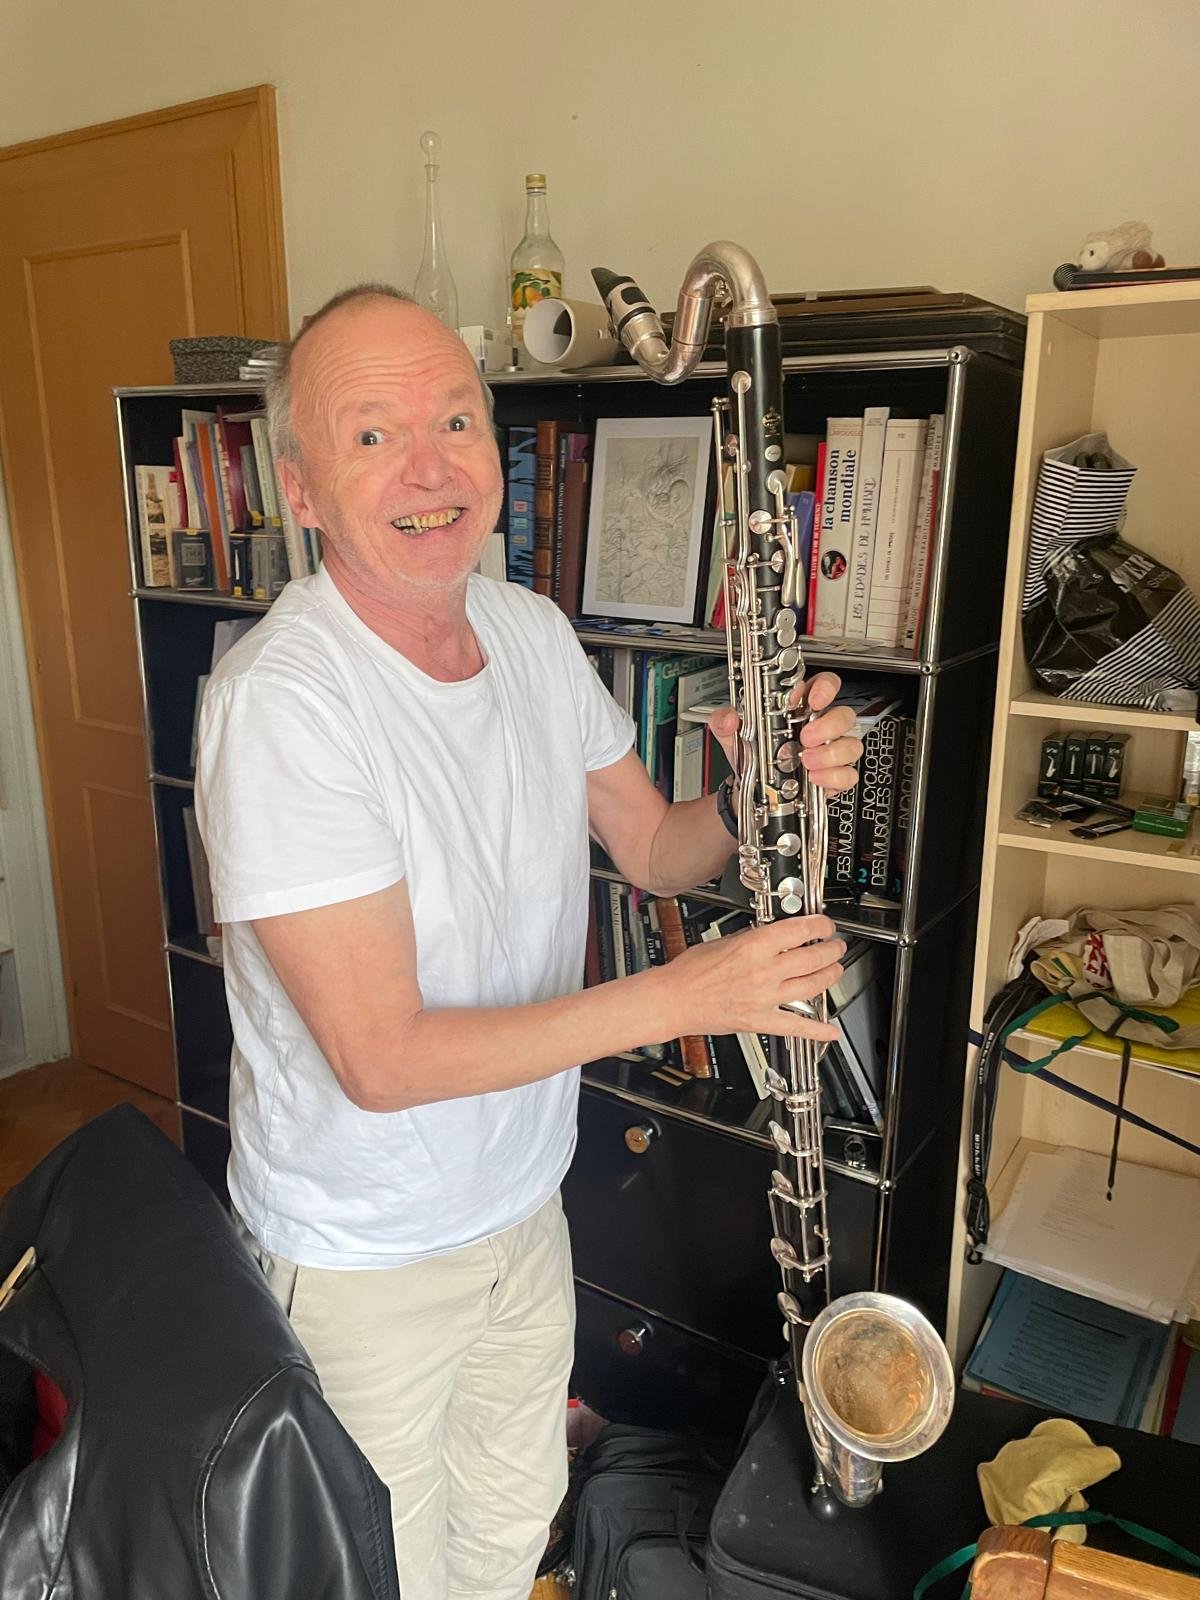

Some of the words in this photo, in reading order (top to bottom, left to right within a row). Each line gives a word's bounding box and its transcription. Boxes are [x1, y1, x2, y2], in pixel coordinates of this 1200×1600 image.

[824, 450, 840, 514] chanson
[840, 450, 857, 523] mondiale
[823, 519, 834, 531] la
[838, 787, 855, 853] MUSIQUES
[873, 787, 890, 857] MUSIQUES
[836, 855, 851, 882] DES
[858, 867, 868, 884] 2
[871, 859, 886, 886] DES
[646, 938, 656, 959] BRUT
